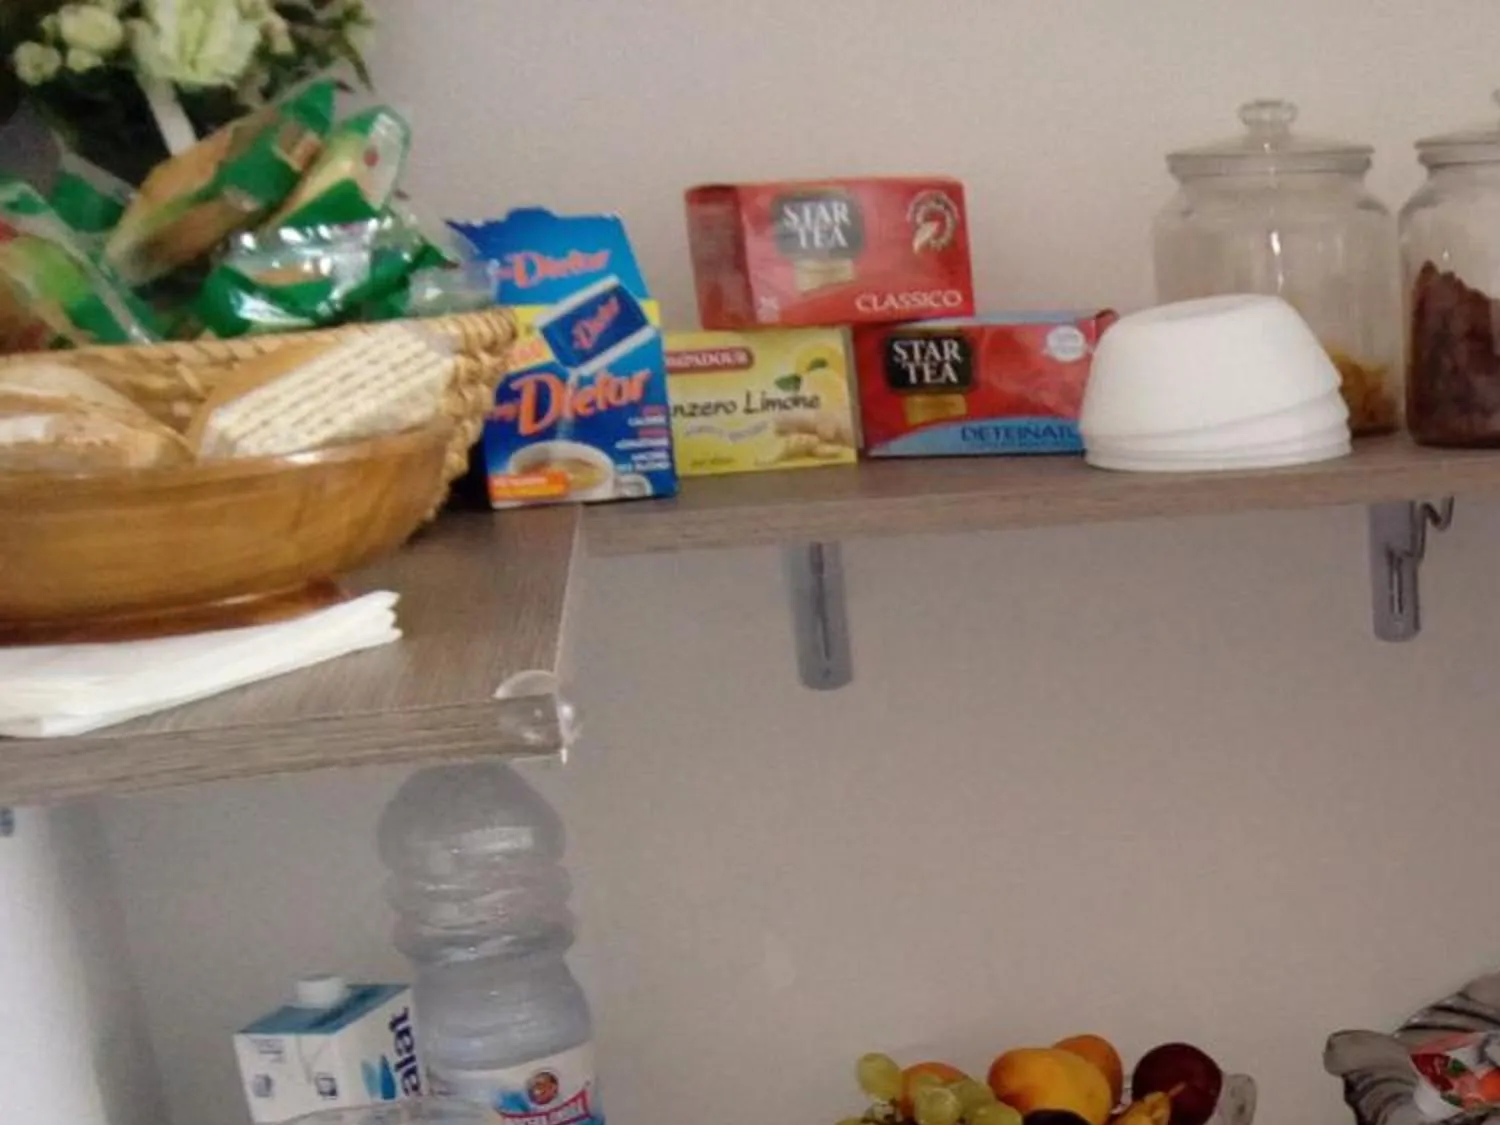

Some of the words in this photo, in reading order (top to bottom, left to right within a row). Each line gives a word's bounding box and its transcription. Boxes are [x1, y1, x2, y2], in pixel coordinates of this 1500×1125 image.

[783, 200, 851, 229] STAR
[798, 224, 849, 249] TEA
[854, 290, 962, 313] CLASSICO
[892, 339, 963, 364] STAR
[902, 361, 959, 385] TEA
[510, 367, 651, 436] Dietor
[672, 400, 737, 417] nzero
[743, 389, 821, 415] Limone
